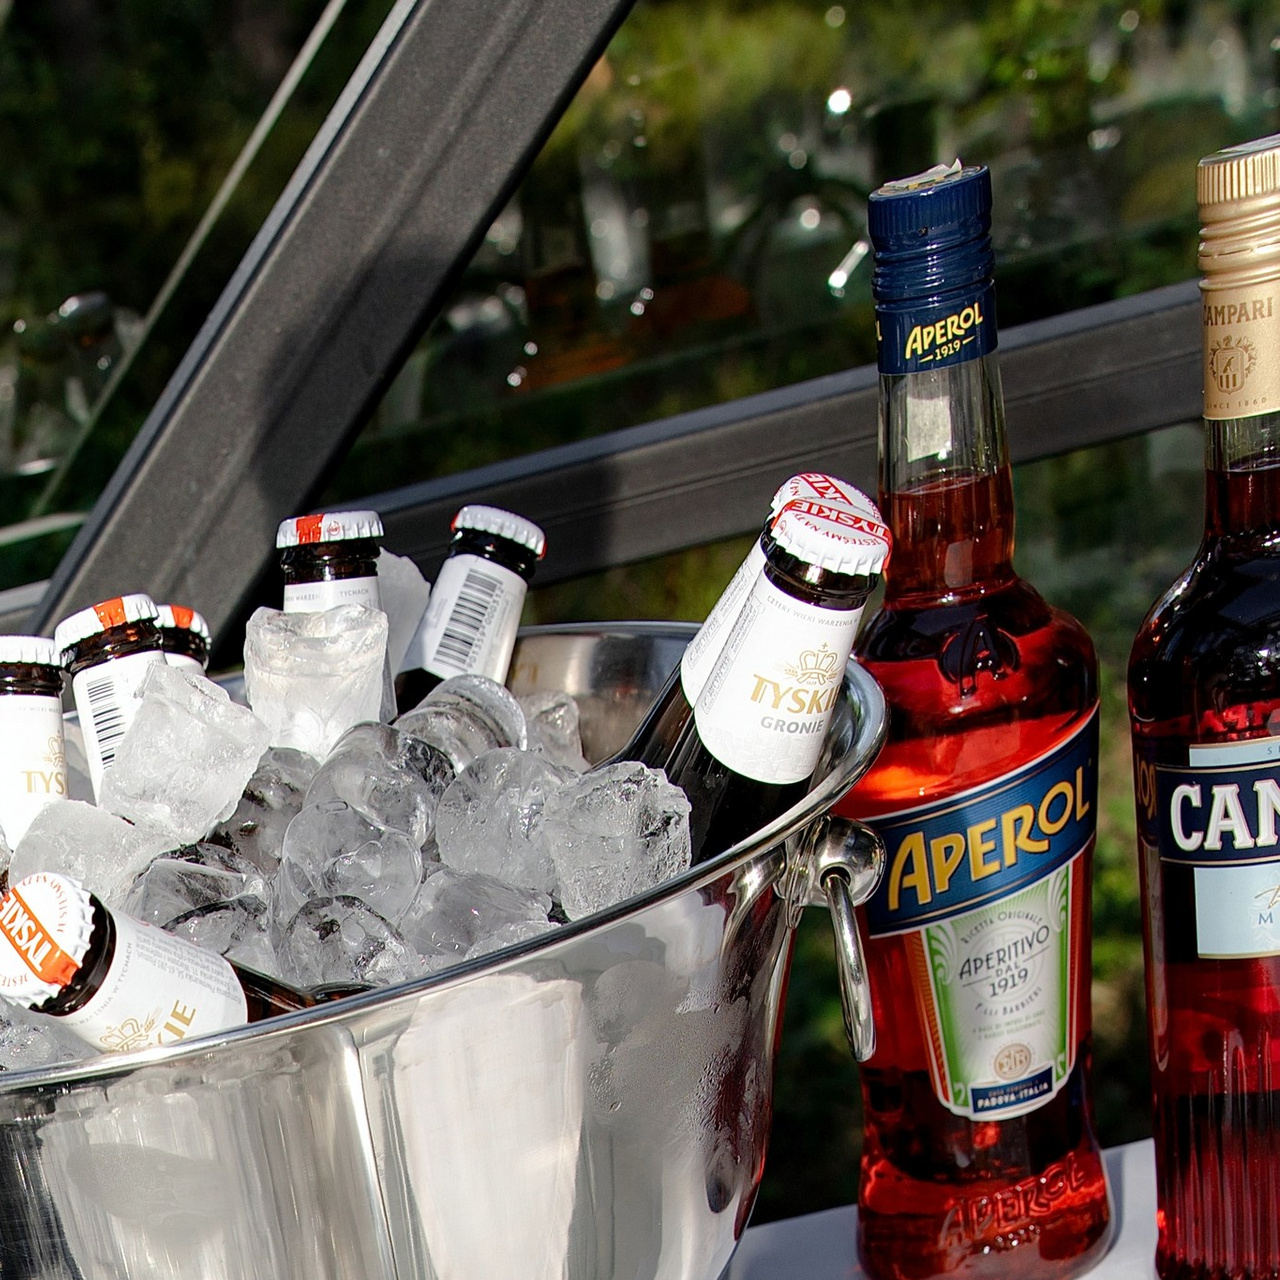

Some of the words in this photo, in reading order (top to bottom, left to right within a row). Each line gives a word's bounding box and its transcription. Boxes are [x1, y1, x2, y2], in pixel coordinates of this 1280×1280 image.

[905, 302, 984, 360] APEROL
[934, 339, 961, 361] 1919
[794, 501, 890, 540] TYSKIE
[760, 716, 824, 735] GRONIE
[887, 766, 1090, 911] APEROL
[959, 925, 1050, 980] APERITIVO
[989, 968, 1028, 997] 1919
[995, 962, 1021, 978] DAL
